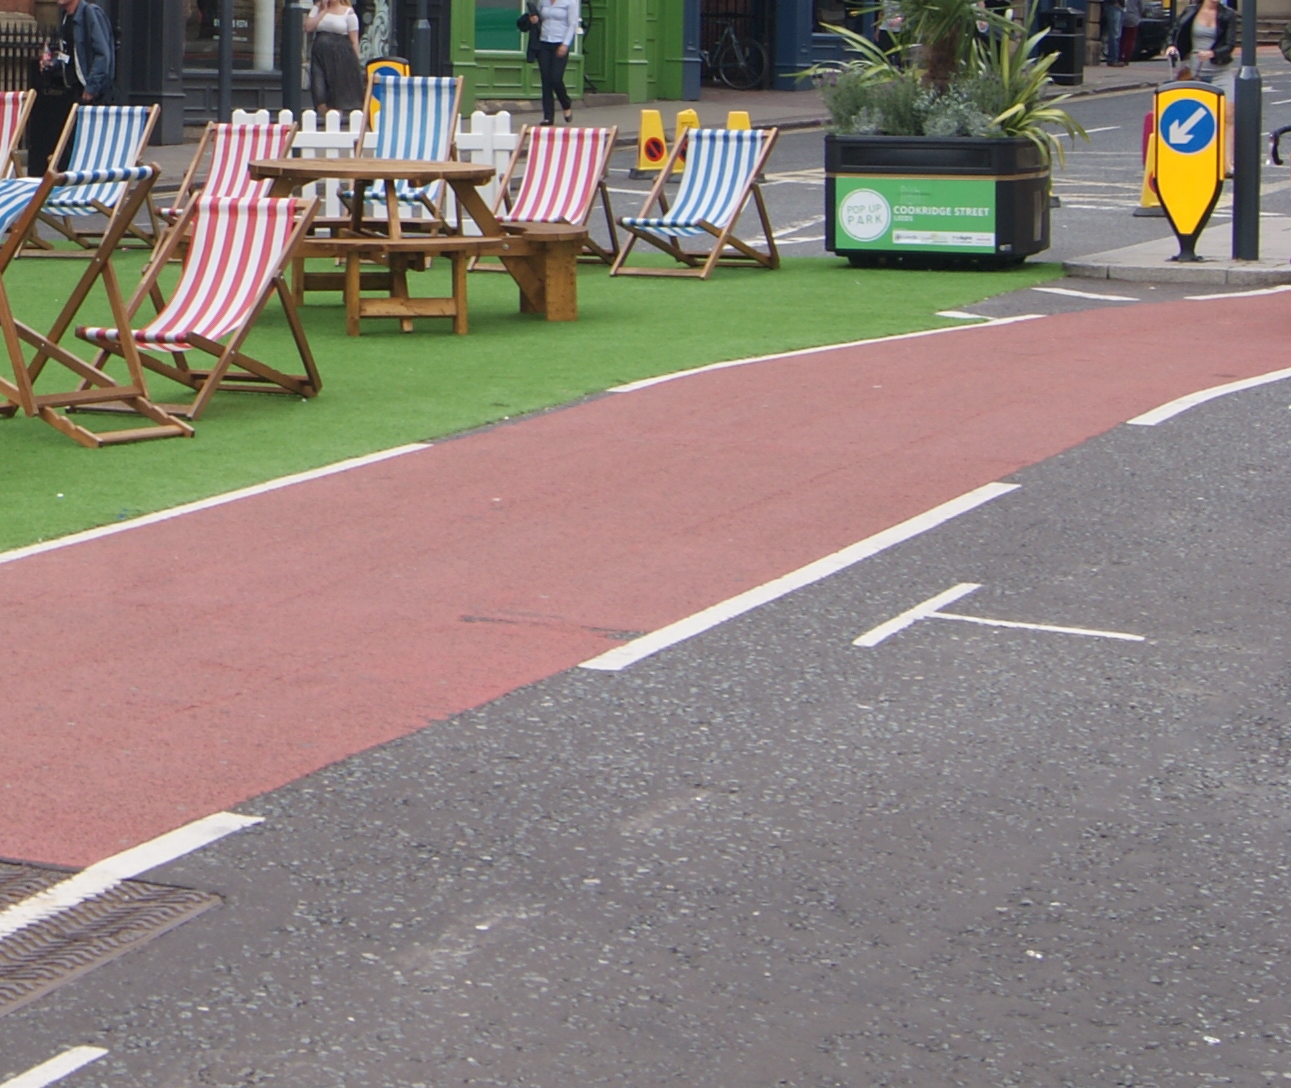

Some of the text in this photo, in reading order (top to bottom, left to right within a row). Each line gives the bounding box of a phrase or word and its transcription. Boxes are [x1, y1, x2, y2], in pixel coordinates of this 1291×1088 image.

[847, 203, 883, 214] POP UP
[893, 205, 990, 217] COOKRIDGE STREET
[847, 214, 883, 226] PARK
